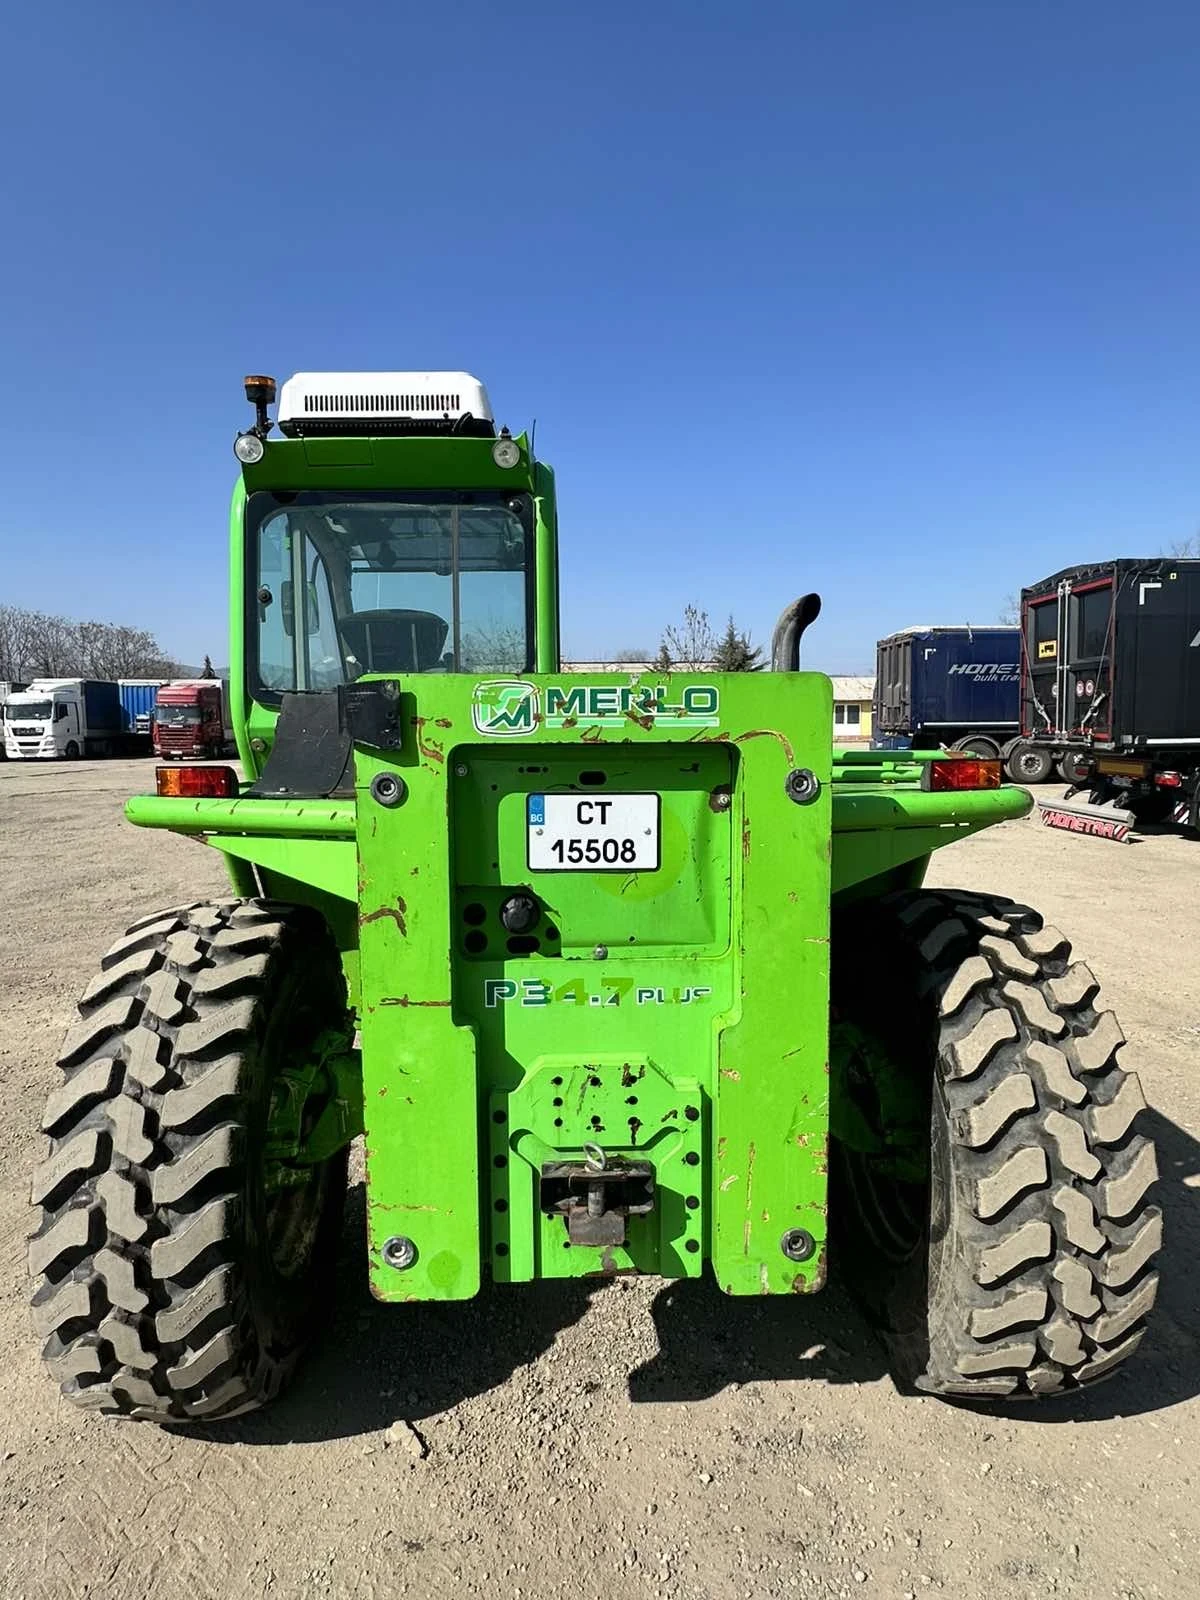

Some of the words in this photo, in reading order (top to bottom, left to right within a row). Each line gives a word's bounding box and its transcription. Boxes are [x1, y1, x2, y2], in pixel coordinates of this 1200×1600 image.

[545, 686, 719, 716] MERLO
[530, 813, 543, 823] BG
[576, 800, 613, 825] CT
[551, 838, 637, 864] 15508
